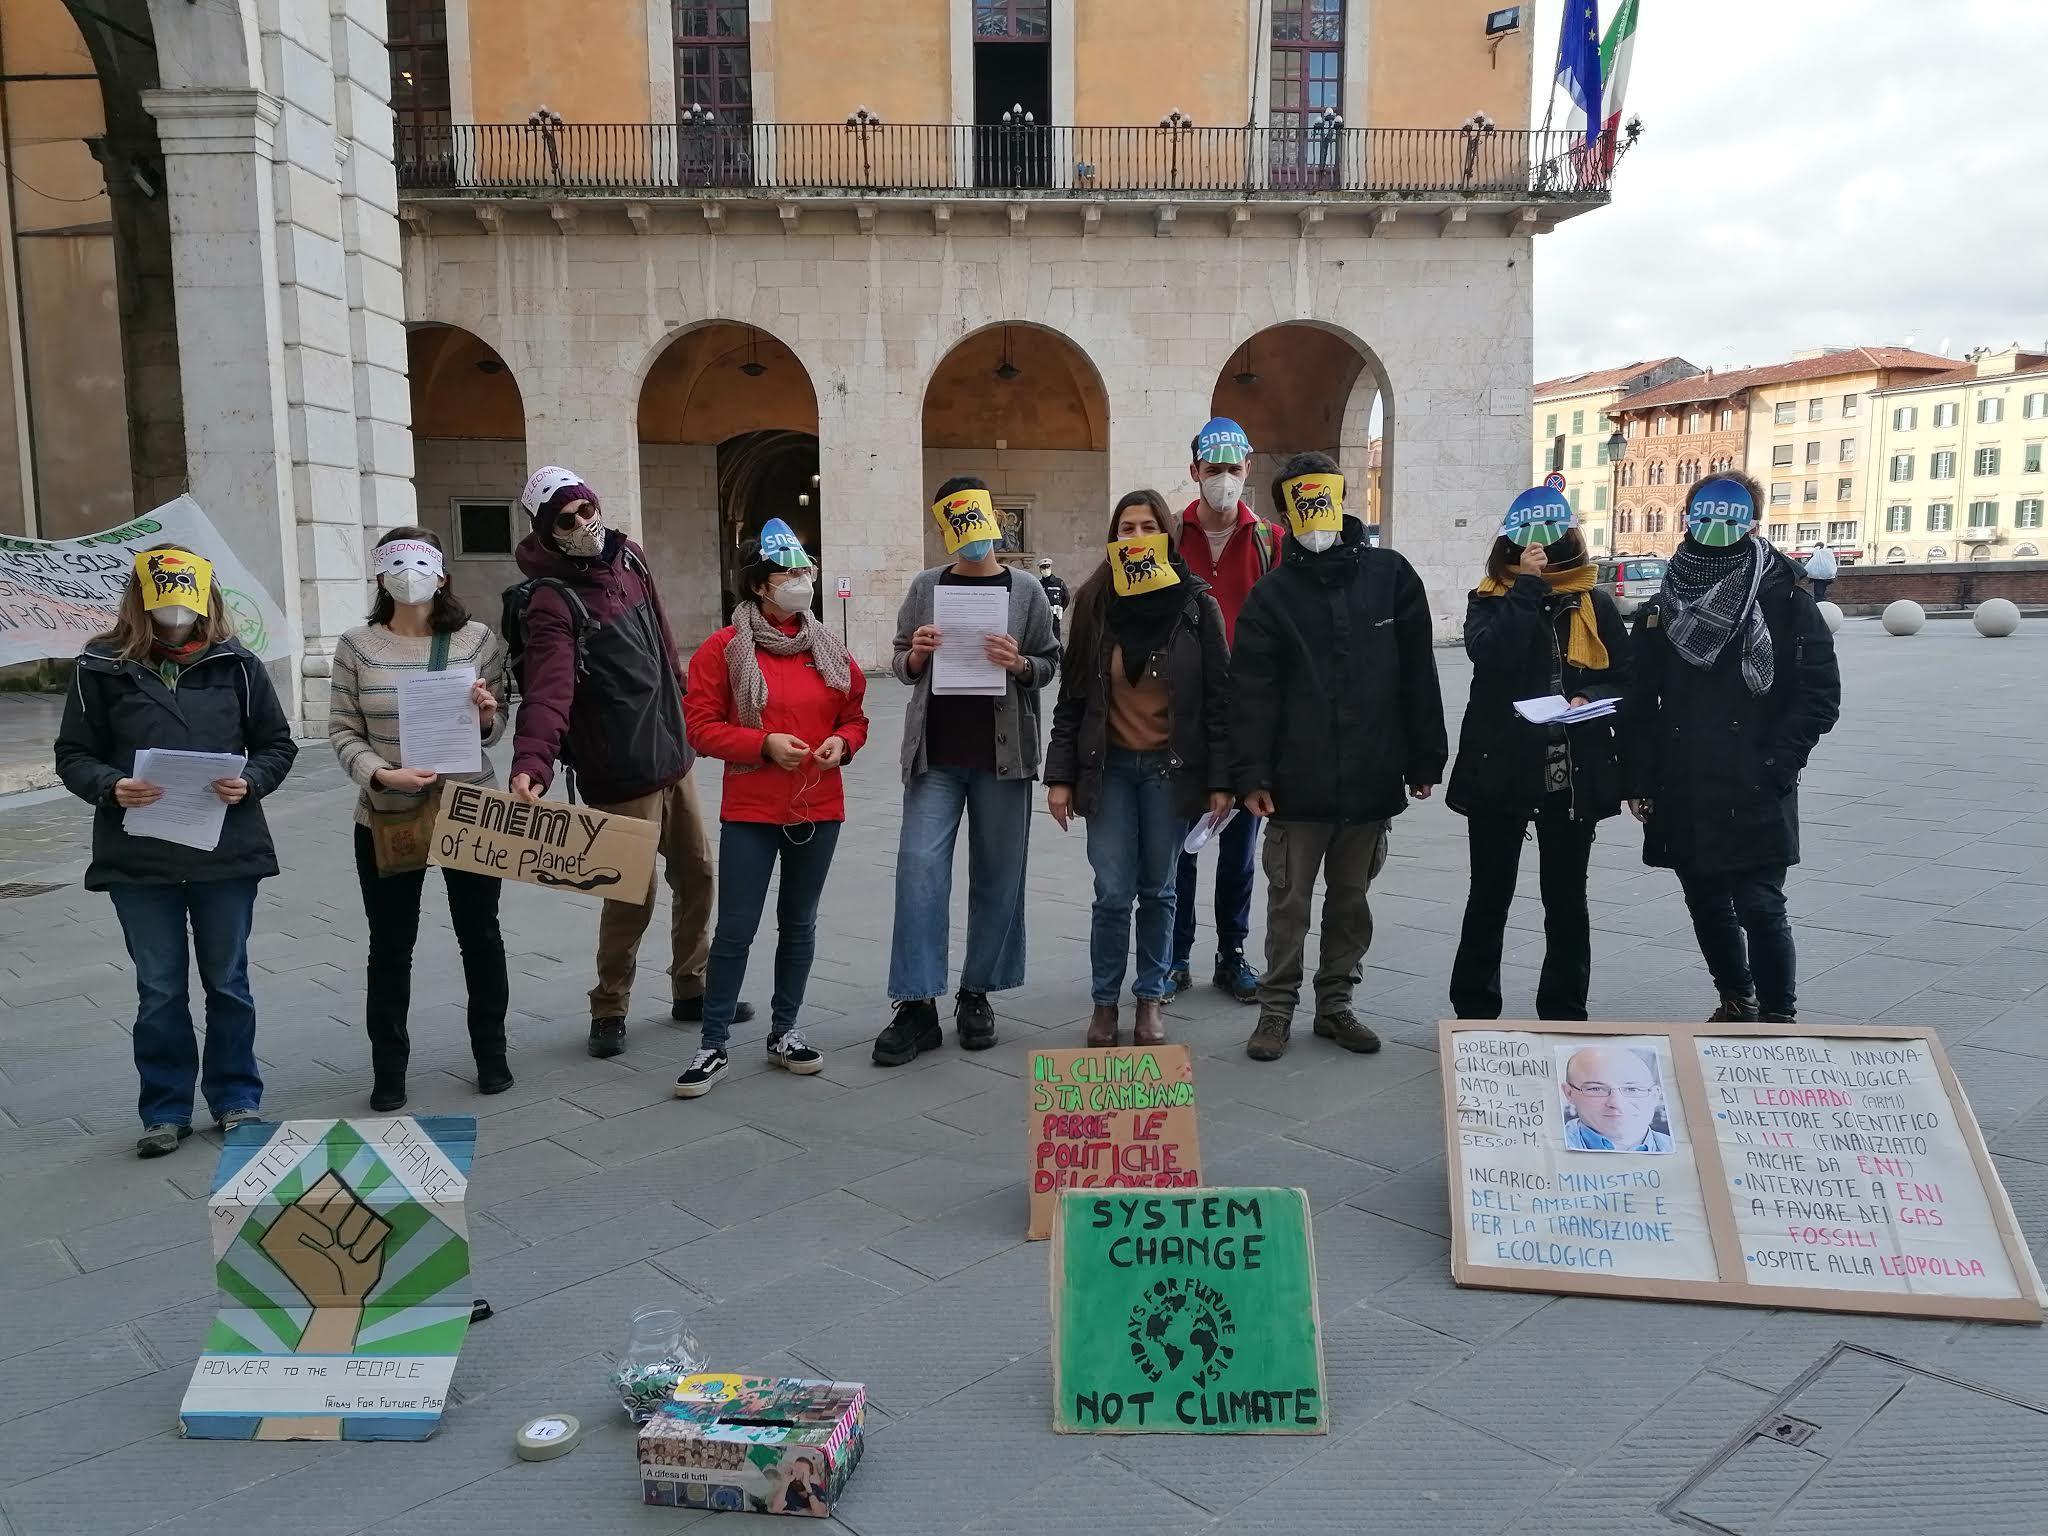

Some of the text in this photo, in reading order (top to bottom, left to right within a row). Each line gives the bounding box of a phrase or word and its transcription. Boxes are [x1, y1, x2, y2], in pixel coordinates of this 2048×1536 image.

[1201, 430, 1246, 448] snam
[1510, 503, 1565, 526] snam
[1693, 500, 1749, 520] snam
[385, 543, 442, 563] LEONARDO
[441, 828, 468, 860] of
[472, 835, 508, 869] the
[1458, 1040, 1530, 1058] ROBERTO
[1710, 1045, 1923, 1066] RESPONSABILE INNOVA-
[1034, 1055, 1063, 1083] IL
[1454, 1056, 1549, 1078] CINGOLANI
[1715, 1066, 1912, 1088] ZIONE TECNOLOGICA
[1034, 1084, 1084, 1112] STA
[1460, 1077, 1520, 1096] NATO IL
[1720, 1087, 1905, 1110] DI LEONARDO (ARMI)
[1133, 1111, 1168, 1140] LE
[1727, 1109, 1939, 1133] DIRETTORE SCIENTIFICO
[1463, 1134, 1517, 1148] SESSO:
[1735, 1131, 1754, 1145] DI
[1812, 1133, 1927, 1156] (FINANZIATO
[215, 1119, 460, 1224] SYSTEM CHANGE
[1746, 1151, 1806, 1173] ANCHE
[1818, 1157, 1841, 1173] DA
[1469, 1168, 1661, 1192] INCARICO: MINISTRO
[1745, 1173, 1944, 1203] INTERVISTE A ENI
[1092, 1197, 1262, 1230] SYSTEM
[1532, 1192, 1636, 1215] AMBIENTE
[1656, 1196, 1667, 1215] E
[1751, 1199, 1944, 1226] A FAVORE DEI GAS
[1471, 1212, 1675, 1242] PER LA TRANSIZIONE
[1788, 1226, 1878, 1248] FOSSILI
[1108, 1234, 1265, 1270] CHANGE
[1496, 1240, 1614, 1268] ECOLOGICA
[1755, 1250, 1986, 1278] OSPITE ALLA LEOPOLDA
[1128, 1277, 1236, 1390] FRIDAYS FOR FUTURE PISA
[202, 1360, 425, 1379] POWER TO THE PEOPLE
[1075, 1388, 1318, 1426] NOT CLIMATE
[646, 1468, 708, 1481] A difesa di tutti
